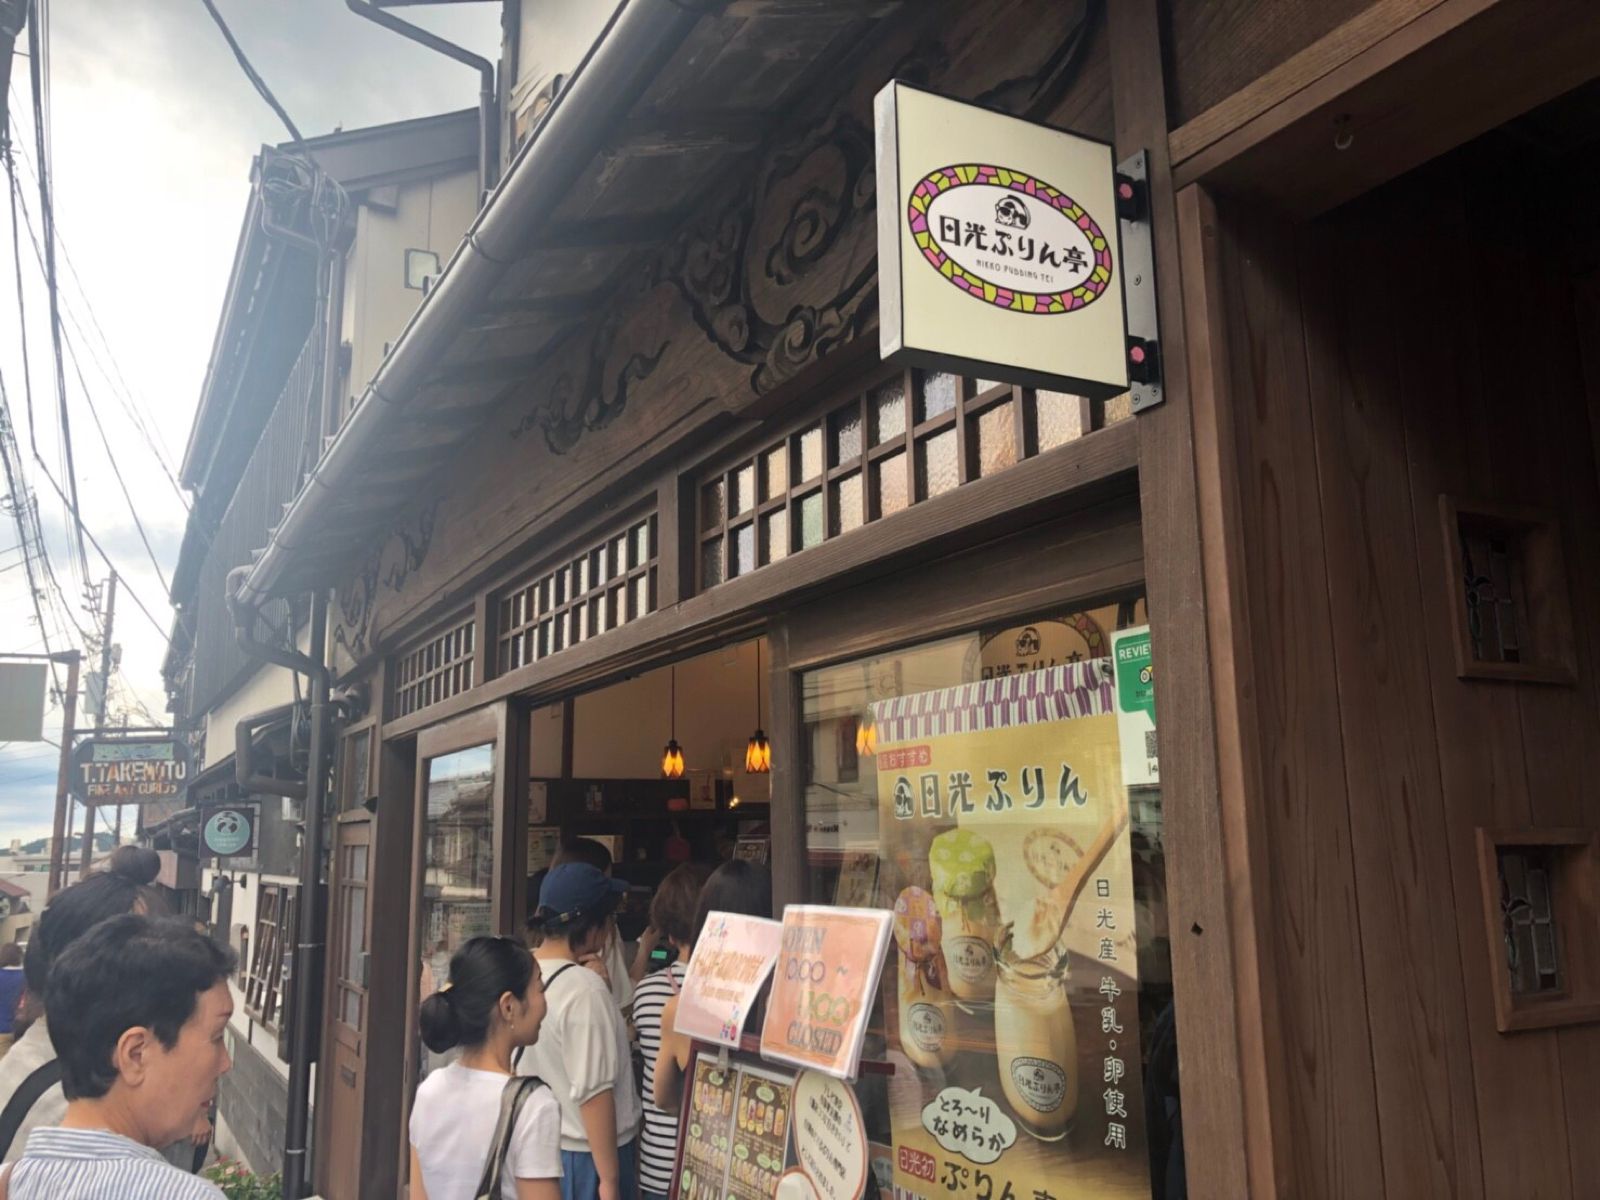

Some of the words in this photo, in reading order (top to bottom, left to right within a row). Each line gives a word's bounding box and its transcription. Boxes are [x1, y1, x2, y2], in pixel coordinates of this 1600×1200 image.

[939, 215, 1089, 274] 日光ぷりん亭
[1118, 644, 1153, 661] REVIE
[919, 763, 1088, 816] 日光ぷりん
[933, 1116, 1006, 1152] なめらか
[941, 1161, 1060, 1200] ぷりん
